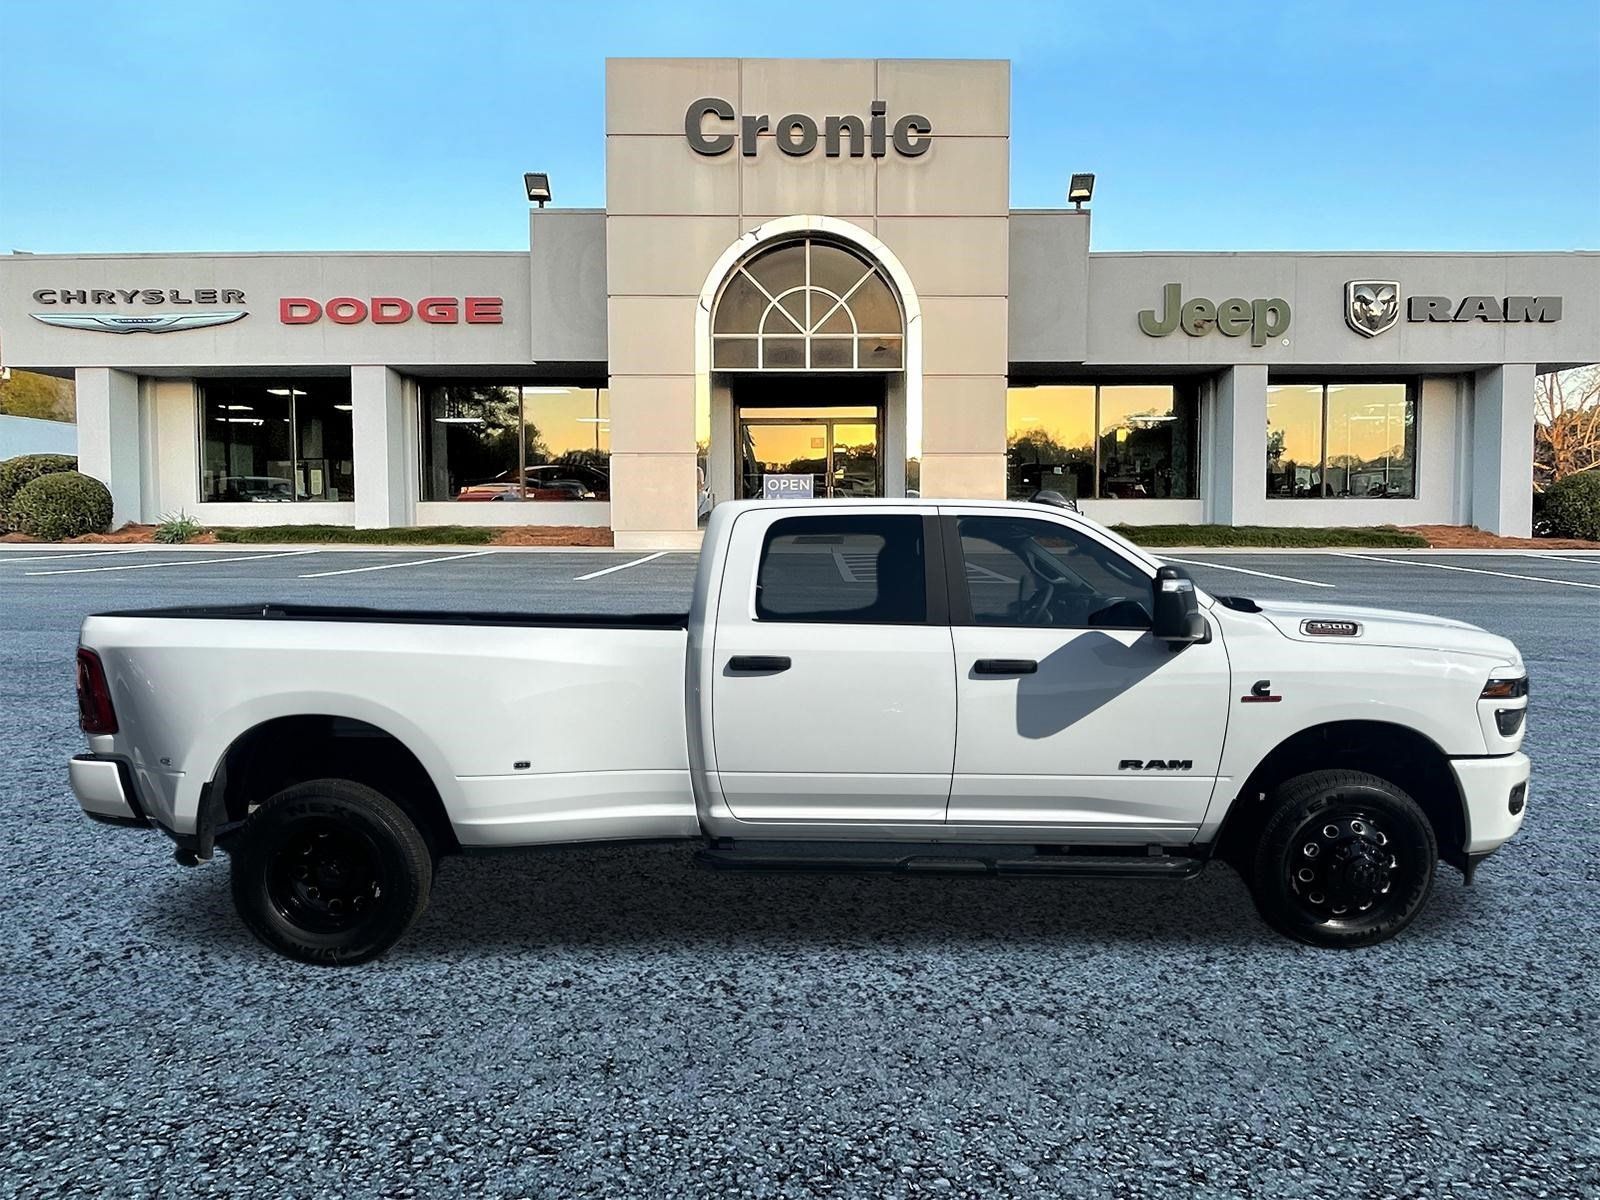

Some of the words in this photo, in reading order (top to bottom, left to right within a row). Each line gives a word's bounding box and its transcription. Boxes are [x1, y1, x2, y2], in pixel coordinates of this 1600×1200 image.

[685, 97, 932, 157] Cronic
[32, 289, 246, 304] CHRYSLER
[1407, 296, 1563, 322] RAM
[279, 297, 504, 324] DODGE
[1138, 283, 1291, 347] Jeep
[767, 479, 810, 491] OPEN
[1118, 759, 1193, 771] RAM
